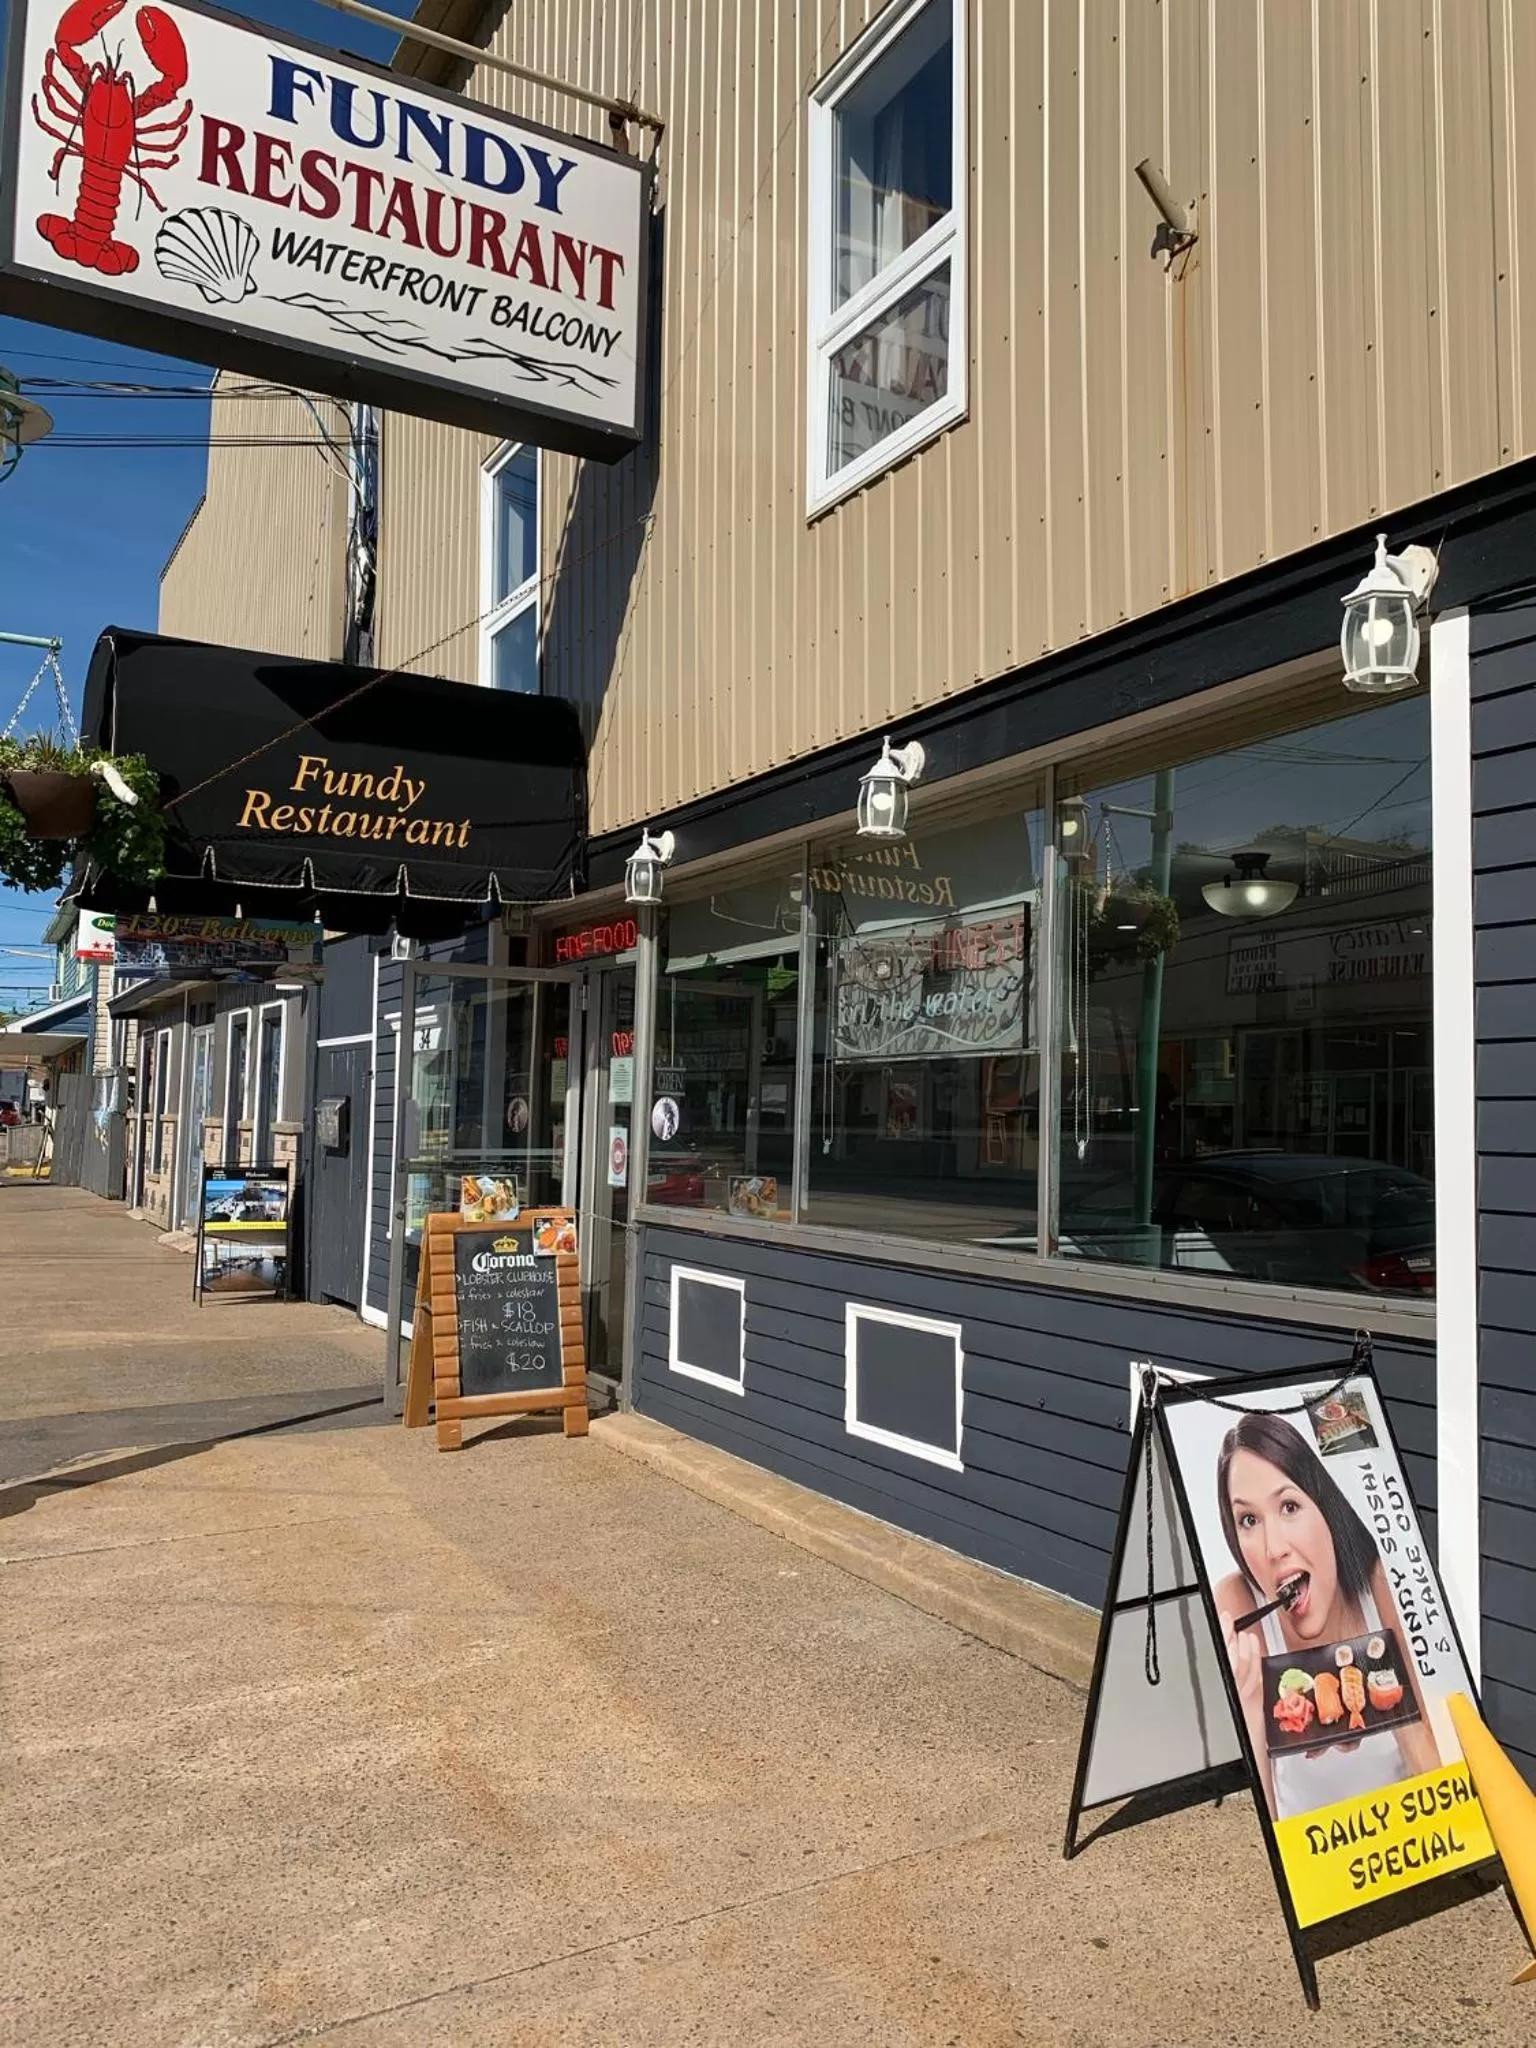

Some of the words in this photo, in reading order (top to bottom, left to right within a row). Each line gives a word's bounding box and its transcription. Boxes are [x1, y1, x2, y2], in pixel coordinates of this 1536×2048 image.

[267, 54, 578, 215] FUNDY
[197, 114, 625, 311] RESTAURANT
[271, 227, 487, 316] WATERFRONT
[490, 295, 622, 357] BALCONY
[289, 755, 425, 812] Fundy
[236, 790, 472, 848] Restaurant
[593, 920, 637, 953] FOOD
[463, 1273, 504, 1286] LOBSTER
[472, 1252, 538, 1273] Corona
[463, 1318, 488, 1333] FISH
[500, 1320, 555, 1334] SCALLOP
[502, 1301, 536, 1322] $18
[505, 1352, 545, 1372] $20
[1357, 1461, 1398, 1554] SUSHI
[1383, 1472, 1410, 1532] OUT
[1405, 1547, 1439, 1626] TAKE
[1390, 1568, 1436, 1677] FUNDY
[1304, 1801, 1390, 1855] DAILY
[1349, 1824, 1465, 1890] SPECIAL
